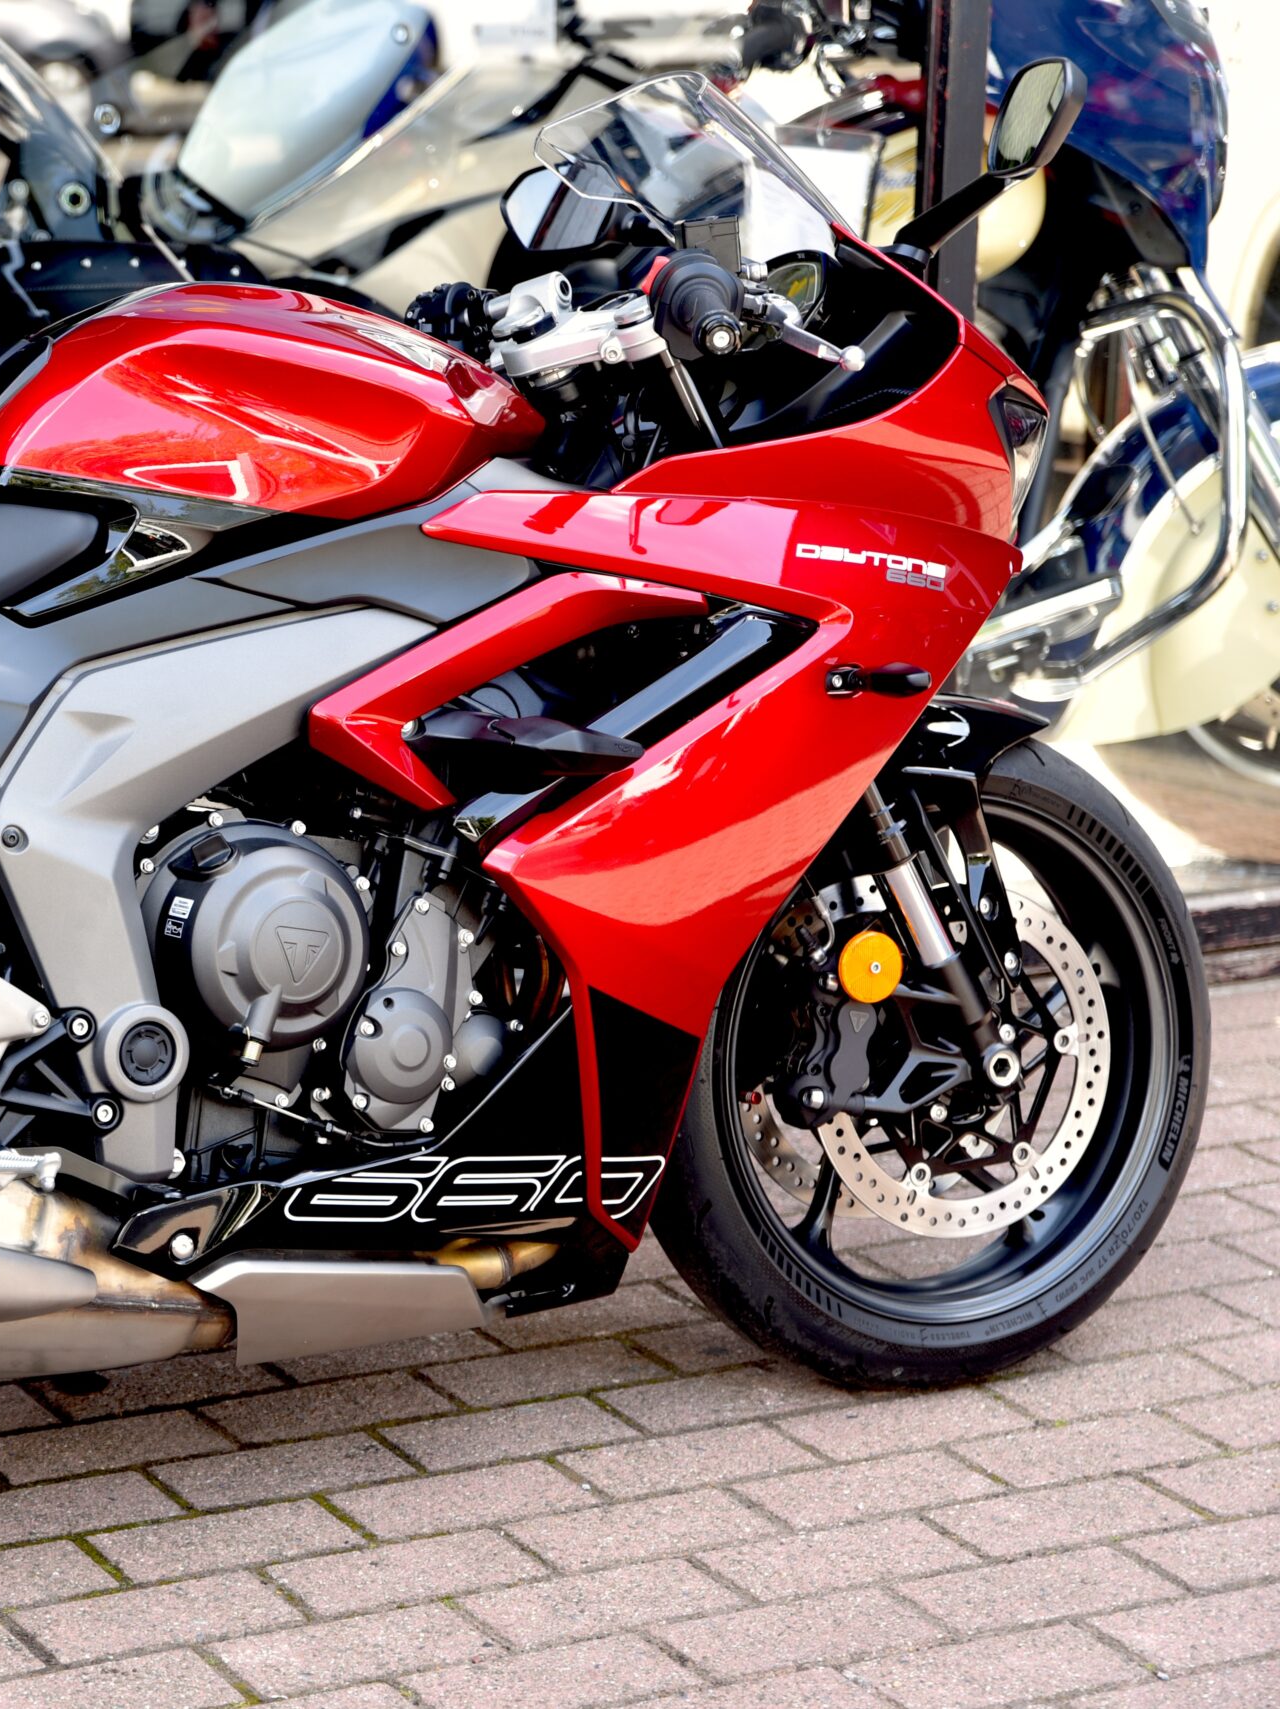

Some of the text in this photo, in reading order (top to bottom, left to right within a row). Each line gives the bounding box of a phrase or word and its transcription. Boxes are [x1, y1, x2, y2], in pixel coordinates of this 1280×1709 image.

[886, 569, 945, 592] 660
[1158, 918, 1175, 951] FRONT
[1160, 1077, 1190, 1166] MICHELIN
[283, 1154, 666, 1223] 660
[1121, 1199, 1149, 1241] 120/70
[1097, 1256, 1108, 1270] 17
[1108, 1240, 1120, 1257] ZR
